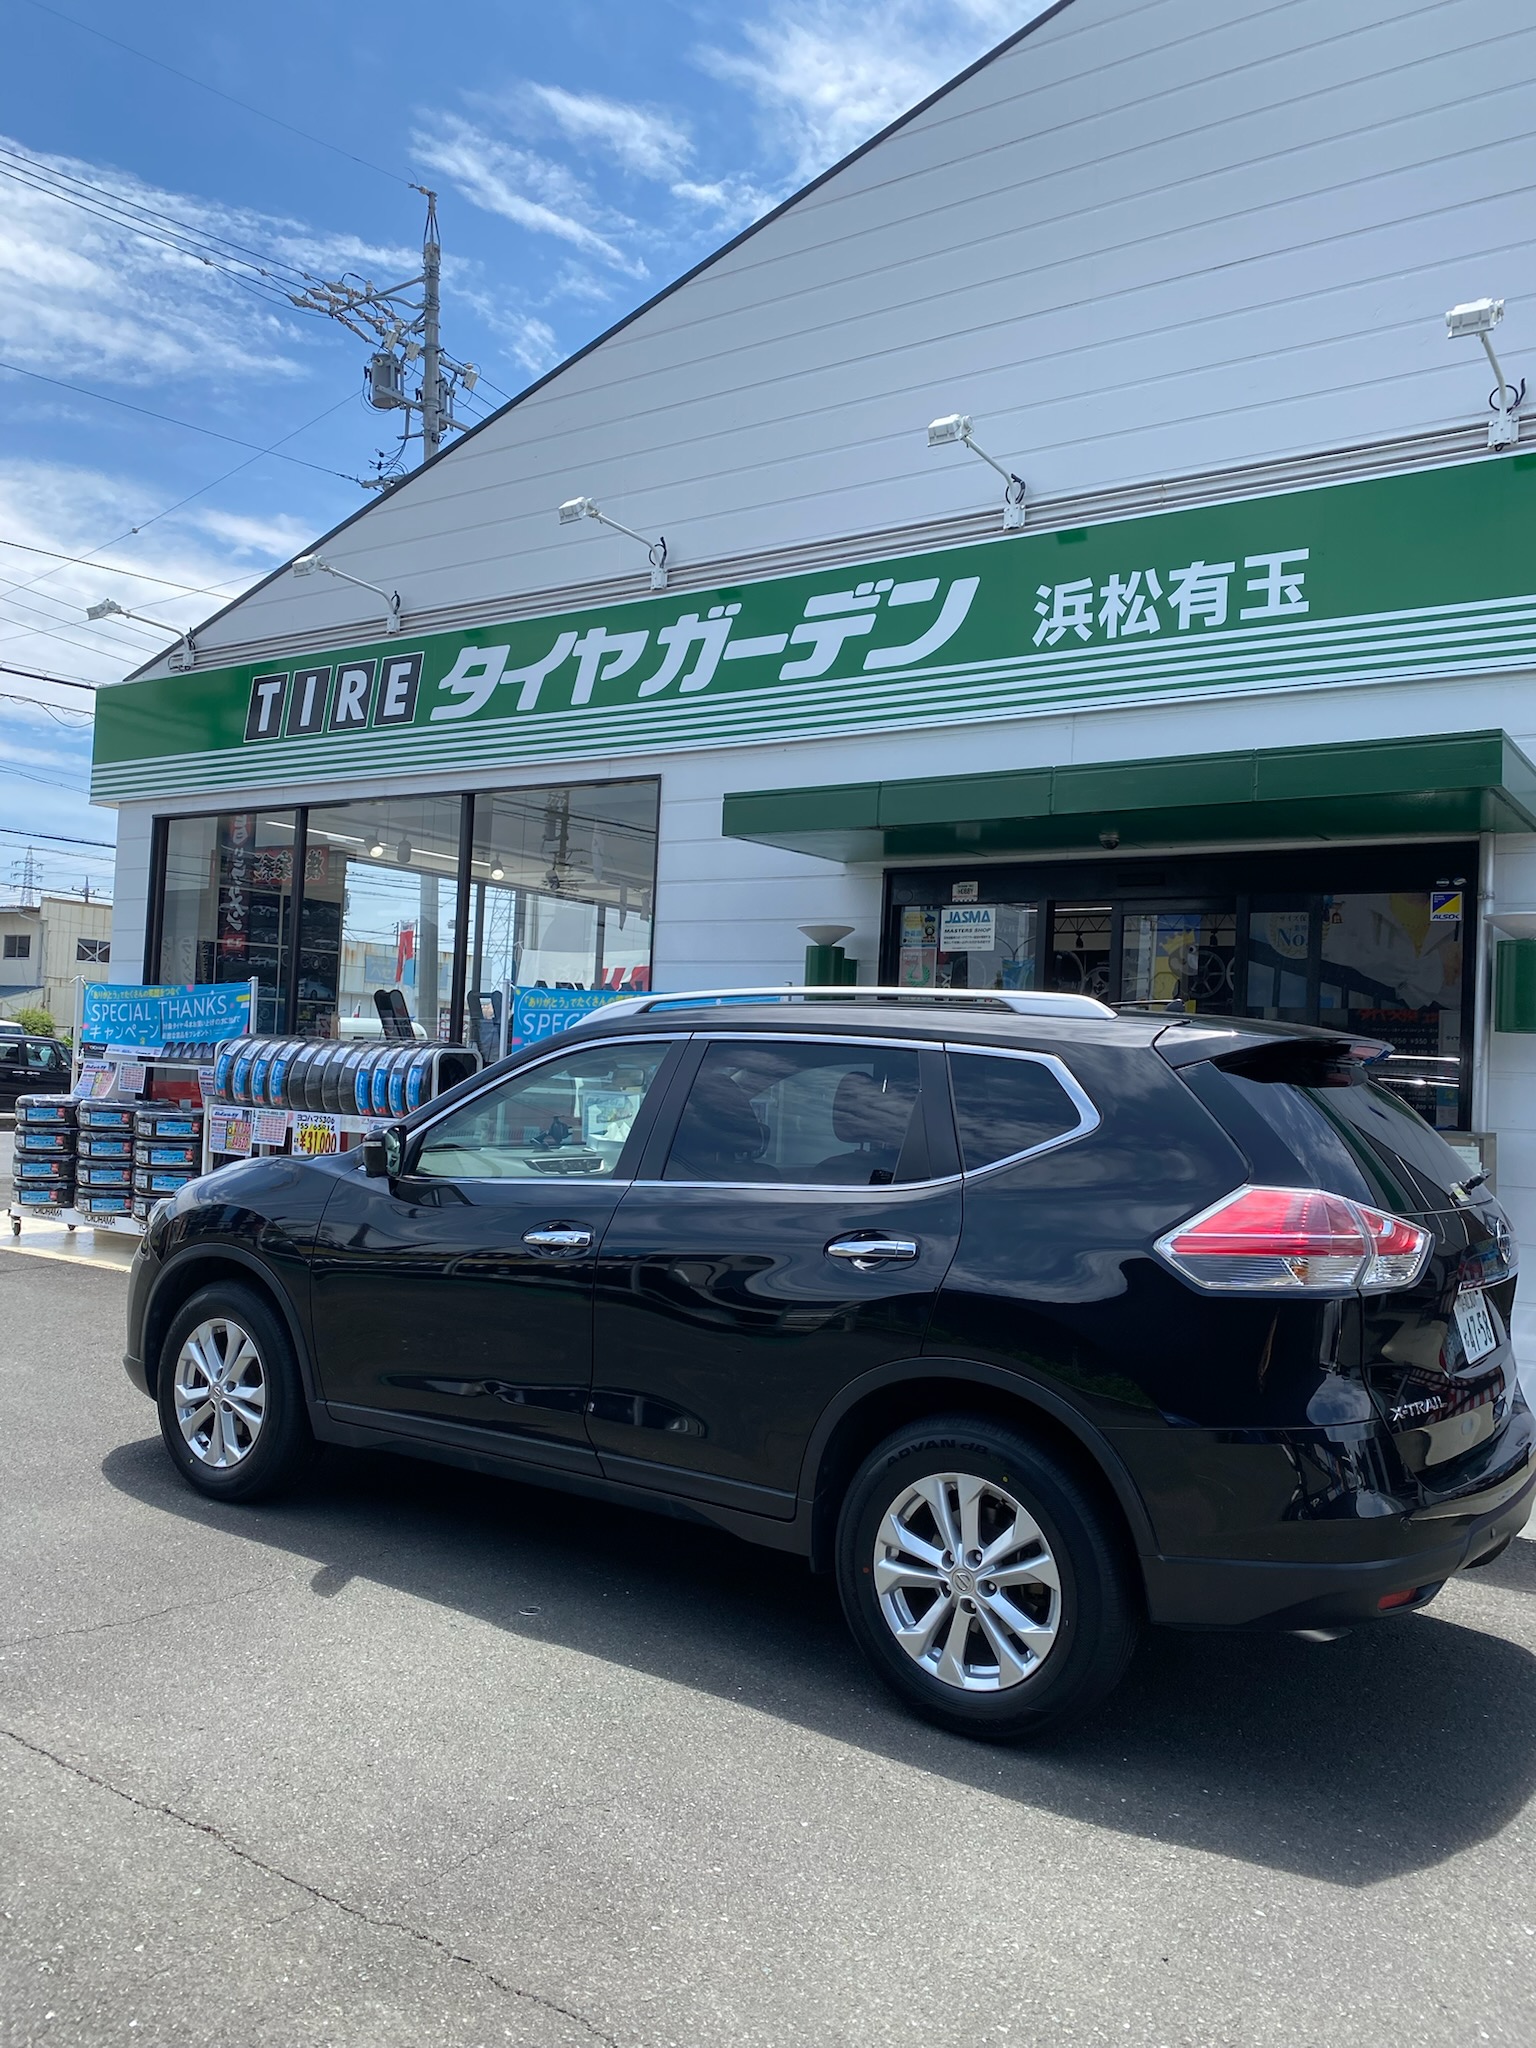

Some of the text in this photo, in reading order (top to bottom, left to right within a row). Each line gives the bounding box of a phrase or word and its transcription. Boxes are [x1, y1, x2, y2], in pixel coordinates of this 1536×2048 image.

[257, 547, 1310, 733] TIRE タイヤガーデン 浜松有玉
[945, 910, 991, 924] JASMA
[90, 995, 227, 1022] SPECIAL THANKS
[89, 1023, 159, 1040] キャンペーン
[85, 1214, 116, 1226] YOKOHAMA
[887, 1439, 989, 1468] ADVAN dB
